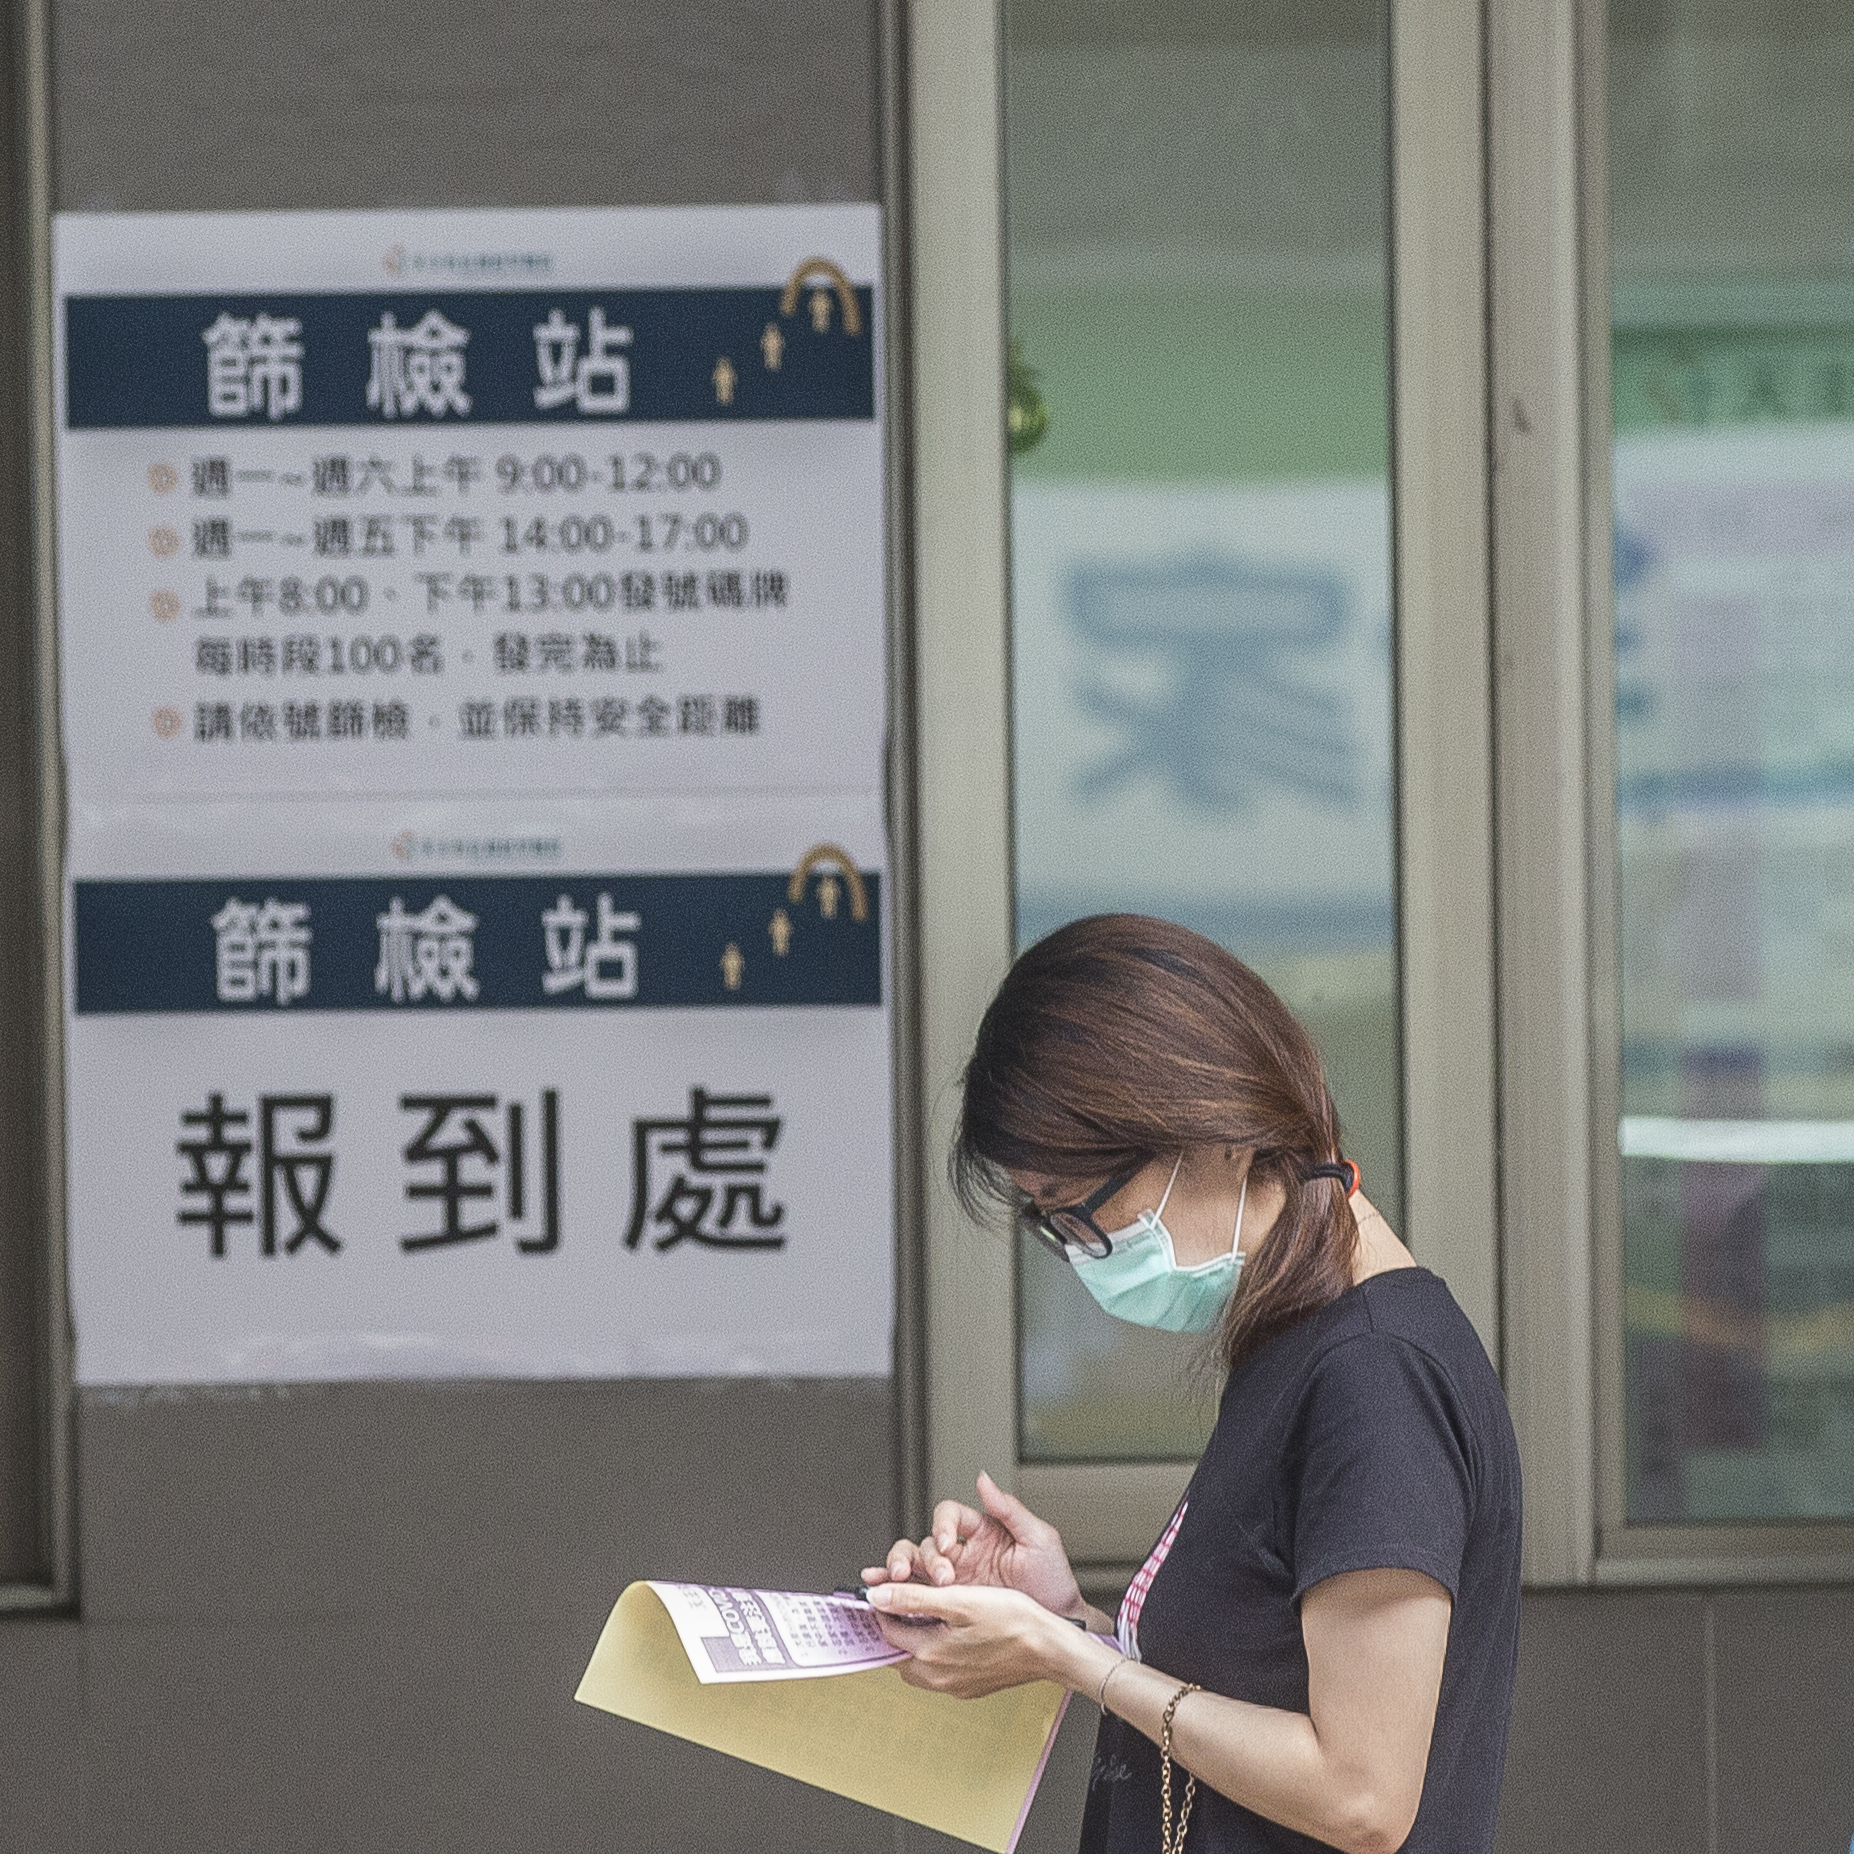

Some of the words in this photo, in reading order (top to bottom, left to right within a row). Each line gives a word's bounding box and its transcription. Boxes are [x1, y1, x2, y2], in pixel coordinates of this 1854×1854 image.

[202, 309, 633, 420] 篩檢站
[496, 453, 722, 494] 9:00-12:00
[499, 513, 748, 554] 14:00-17:00
[211, 891, 641, 1005] 篩檢站
[175, 1085, 788, 1260] 報到處
